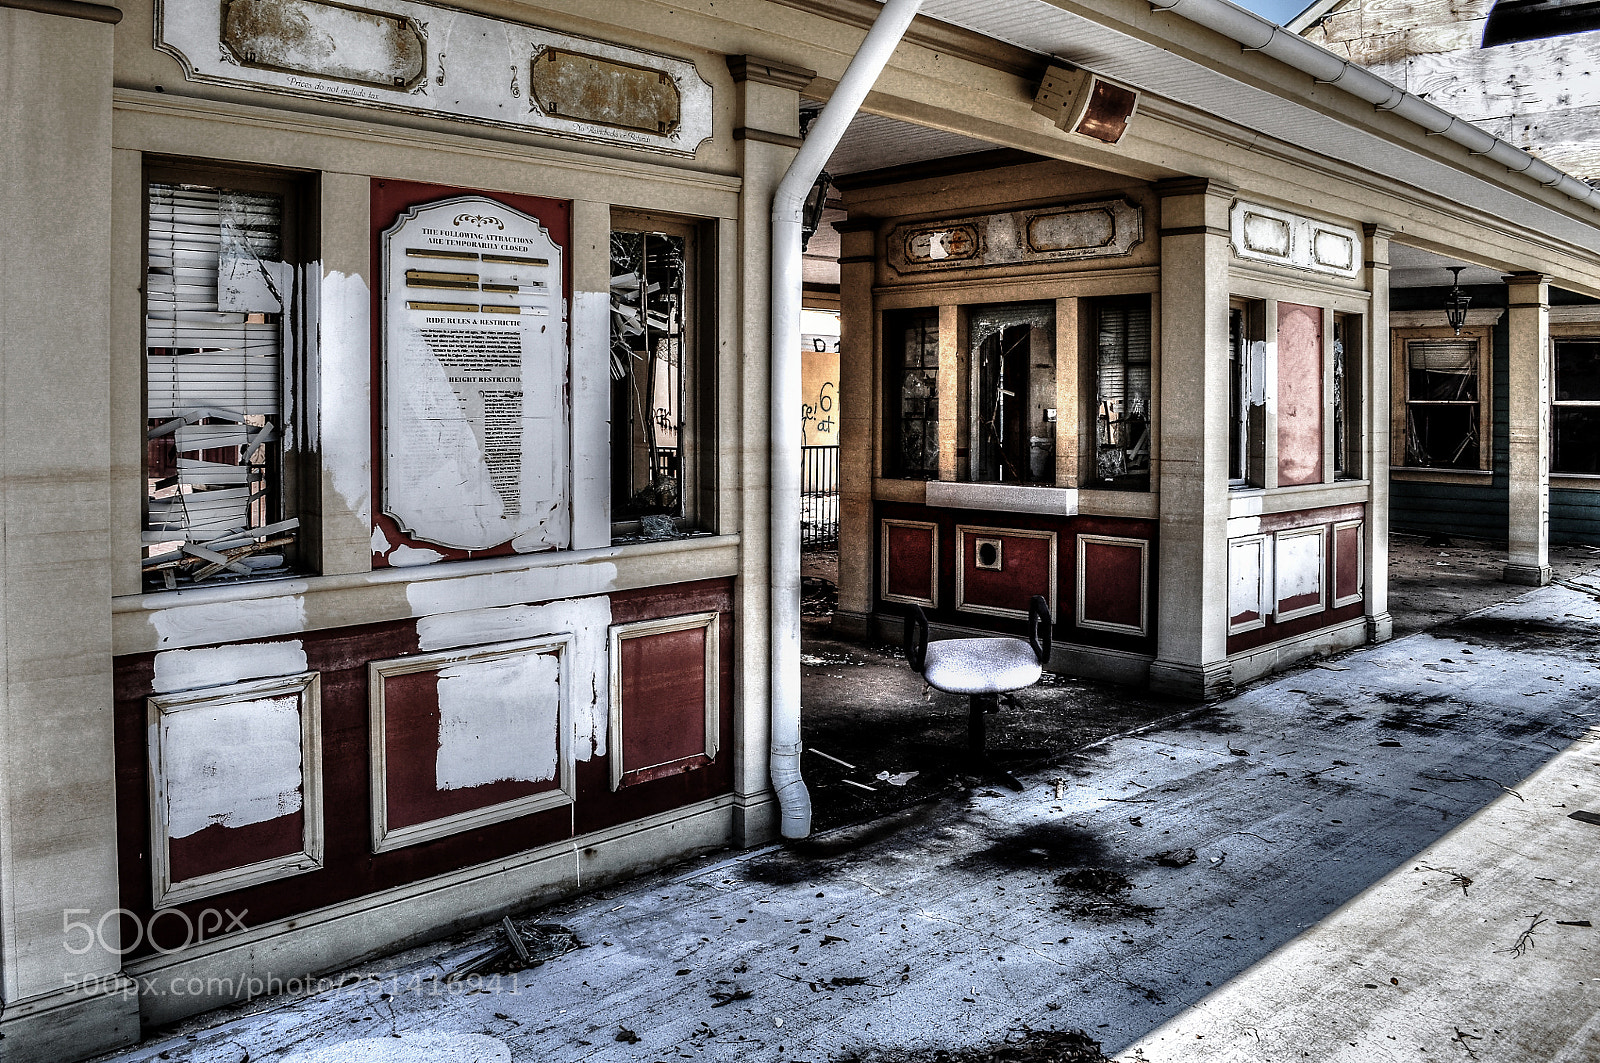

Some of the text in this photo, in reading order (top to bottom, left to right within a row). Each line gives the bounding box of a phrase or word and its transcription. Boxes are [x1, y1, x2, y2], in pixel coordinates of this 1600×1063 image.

[287, 76, 312, 88] Prices
[315, 82, 325, 91] do
[341, 88, 366, 97] include
[368, 92, 380, 100] tax
[572, 123, 585, 131] No
[440, 230, 483, 240] FOLLOWING
[485, 234, 534, 244] ATTRACTIONS
[446, 239, 499, 250] TEMPORARILY
[500, 243, 528, 252] CLOSED
[820, 382, 834, 412] 6
[817, 415, 835, 433] at
